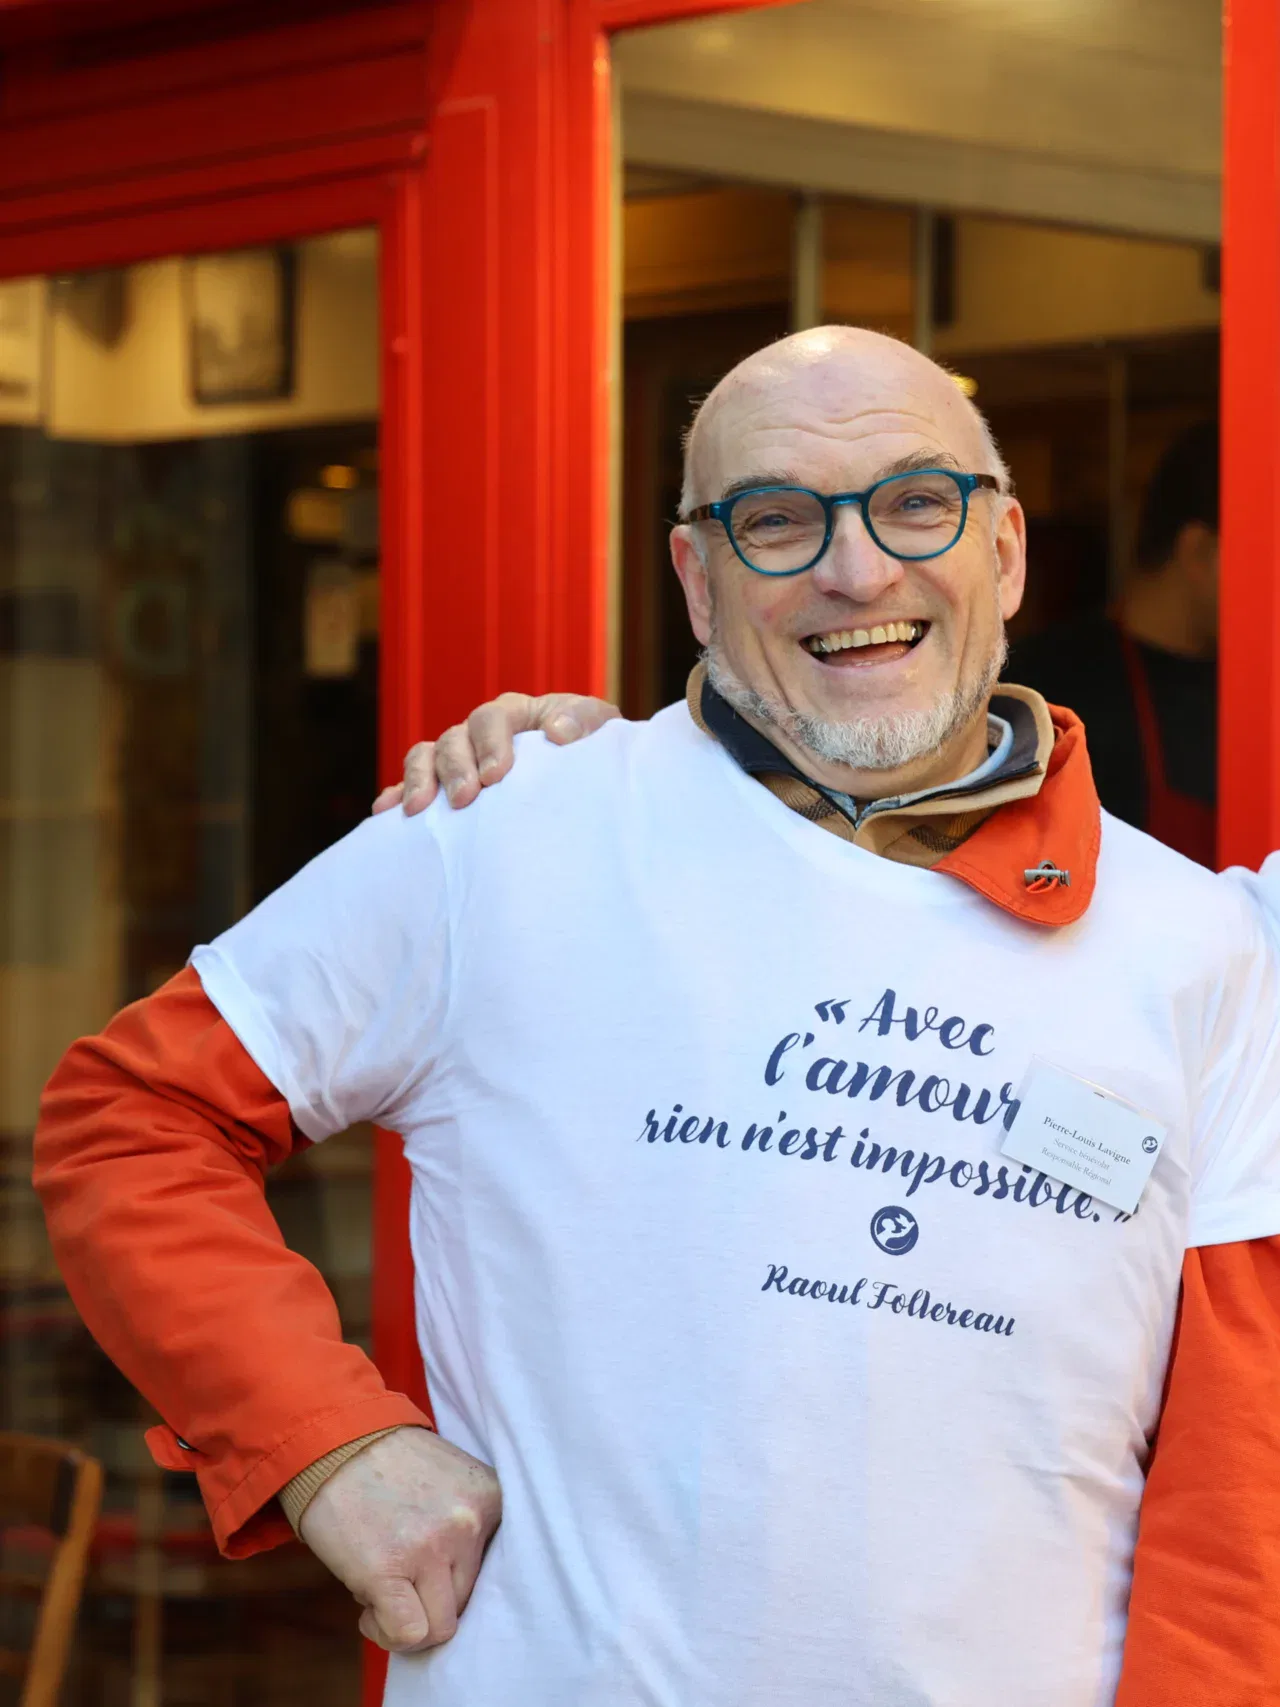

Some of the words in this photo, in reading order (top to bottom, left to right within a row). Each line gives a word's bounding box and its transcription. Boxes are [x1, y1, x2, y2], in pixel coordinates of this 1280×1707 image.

[858, 988, 996, 1057] Avec
[637, 1103, 731, 1150] rien
[740, 1110, 846, 1163] n'est
[1043, 1115, 1096, 1147] Pierre-Louis
[1097, 1142, 1132, 1165] Lavigne
[760, 1263, 867, 1306] Raoul
[867, 1282, 1016, 1337] Follereau
